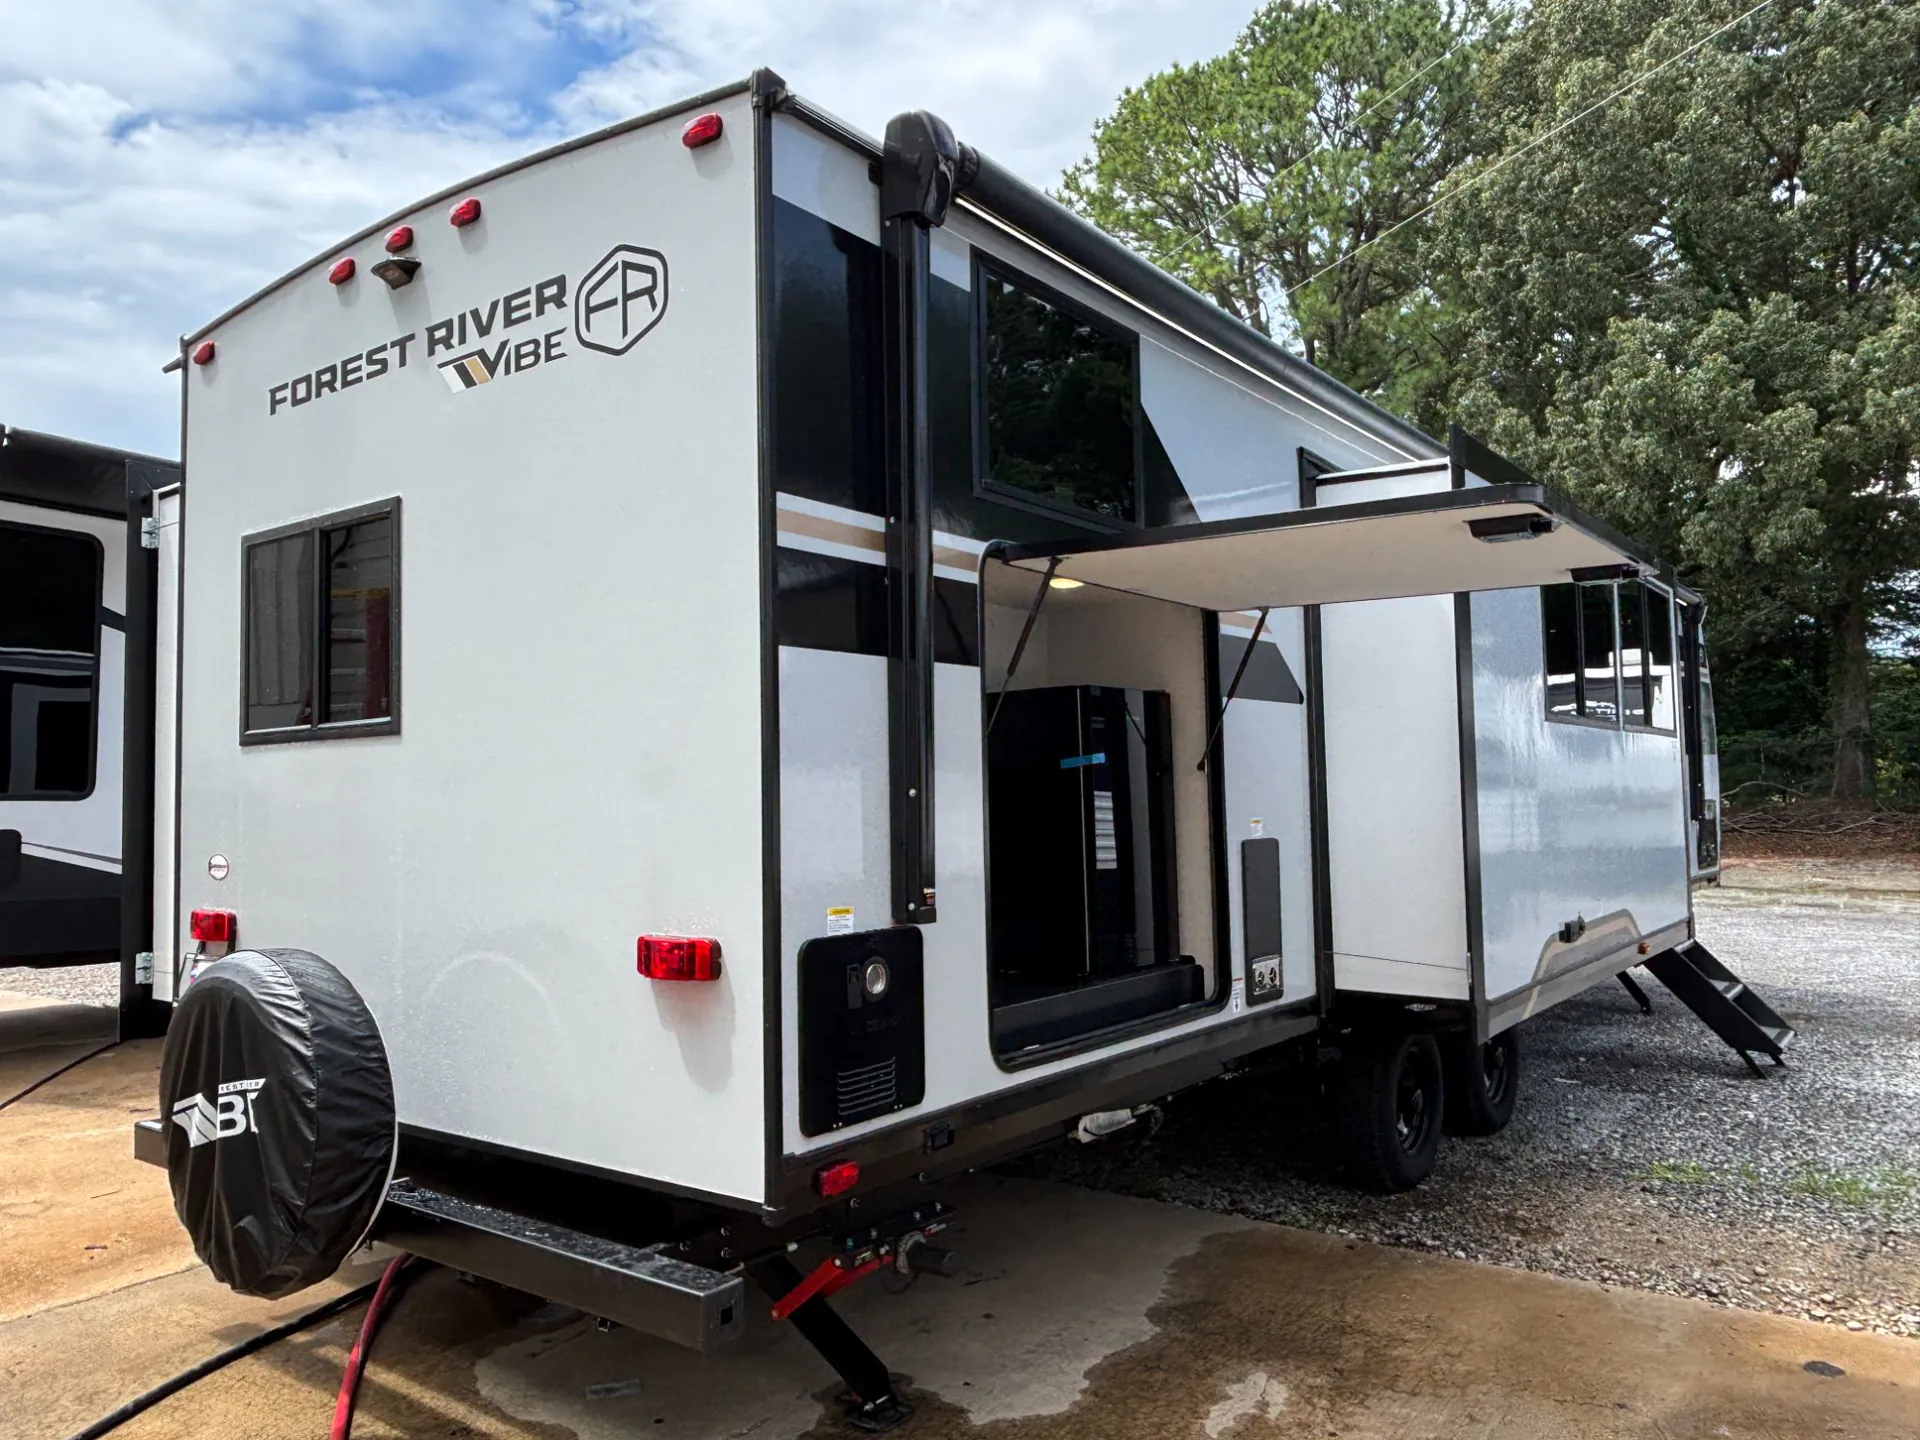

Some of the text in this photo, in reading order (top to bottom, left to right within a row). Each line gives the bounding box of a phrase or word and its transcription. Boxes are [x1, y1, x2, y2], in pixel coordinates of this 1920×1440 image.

[268, 273, 568, 416] FOREST RIVER
[443, 326, 568, 384] VIBE
